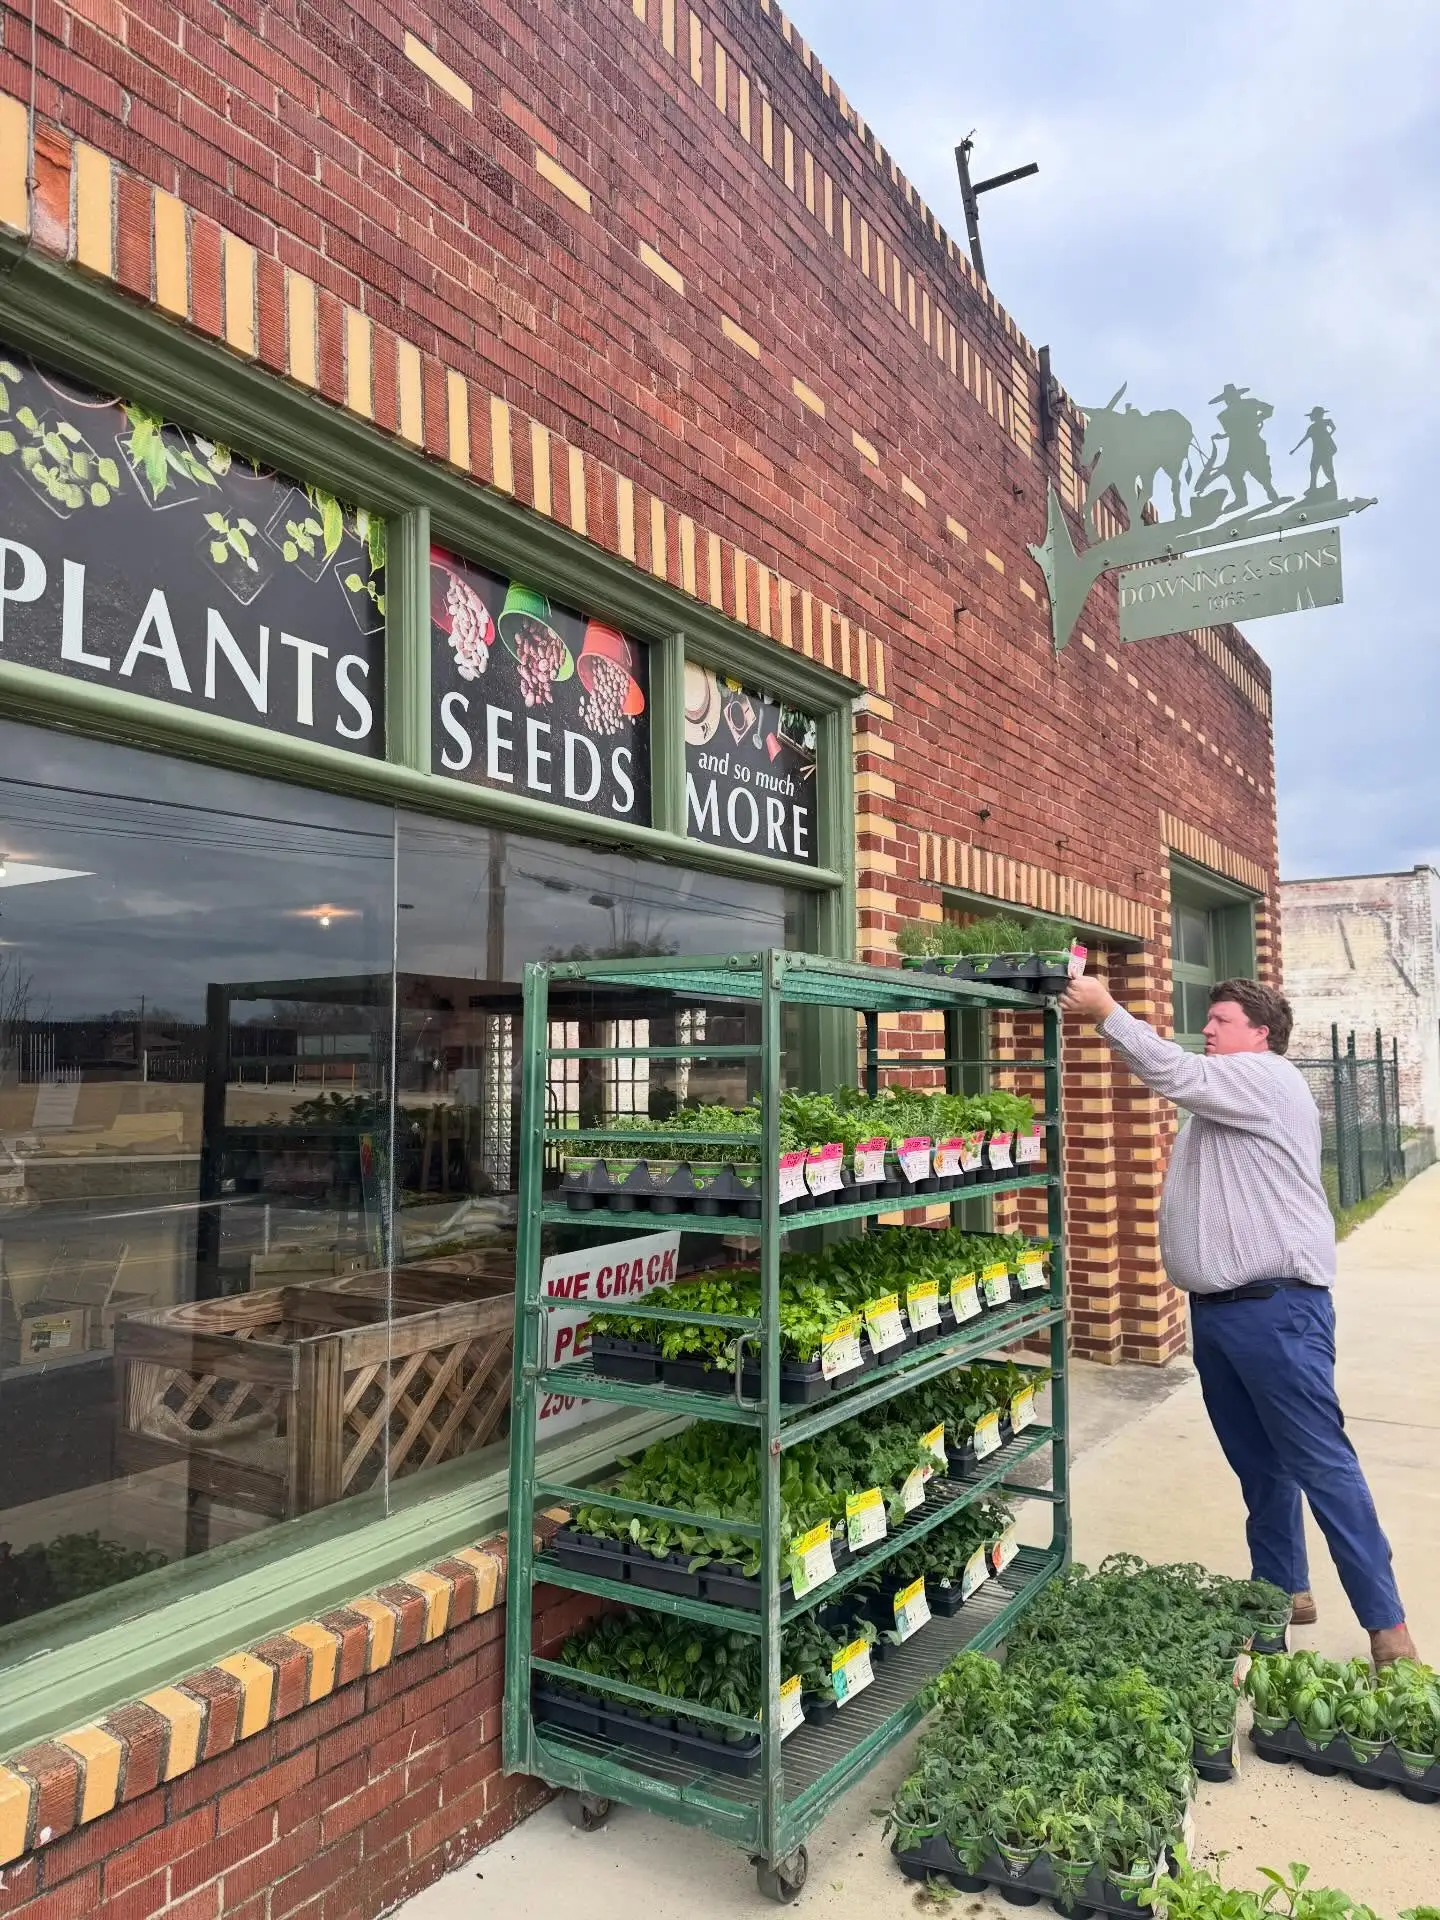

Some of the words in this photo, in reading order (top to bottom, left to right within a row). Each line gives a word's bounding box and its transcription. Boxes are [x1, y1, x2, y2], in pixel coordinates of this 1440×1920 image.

[1121, 564, 1237, 608] DOWNING
[1242, 560, 1263, 582] &
[1268, 544, 1338, 577] SONS
[0, 537, 374, 740] PLANTS
[440, 691, 636, 813] SEEDS
[698, 750, 730, 778] and
[734, 763, 751, 784] so
[755, 770, 795, 797] much
[685, 772, 809, 858] MORE
[547, 1271, 591, 1312] WE
[596, 1248, 677, 1300] CRACK
